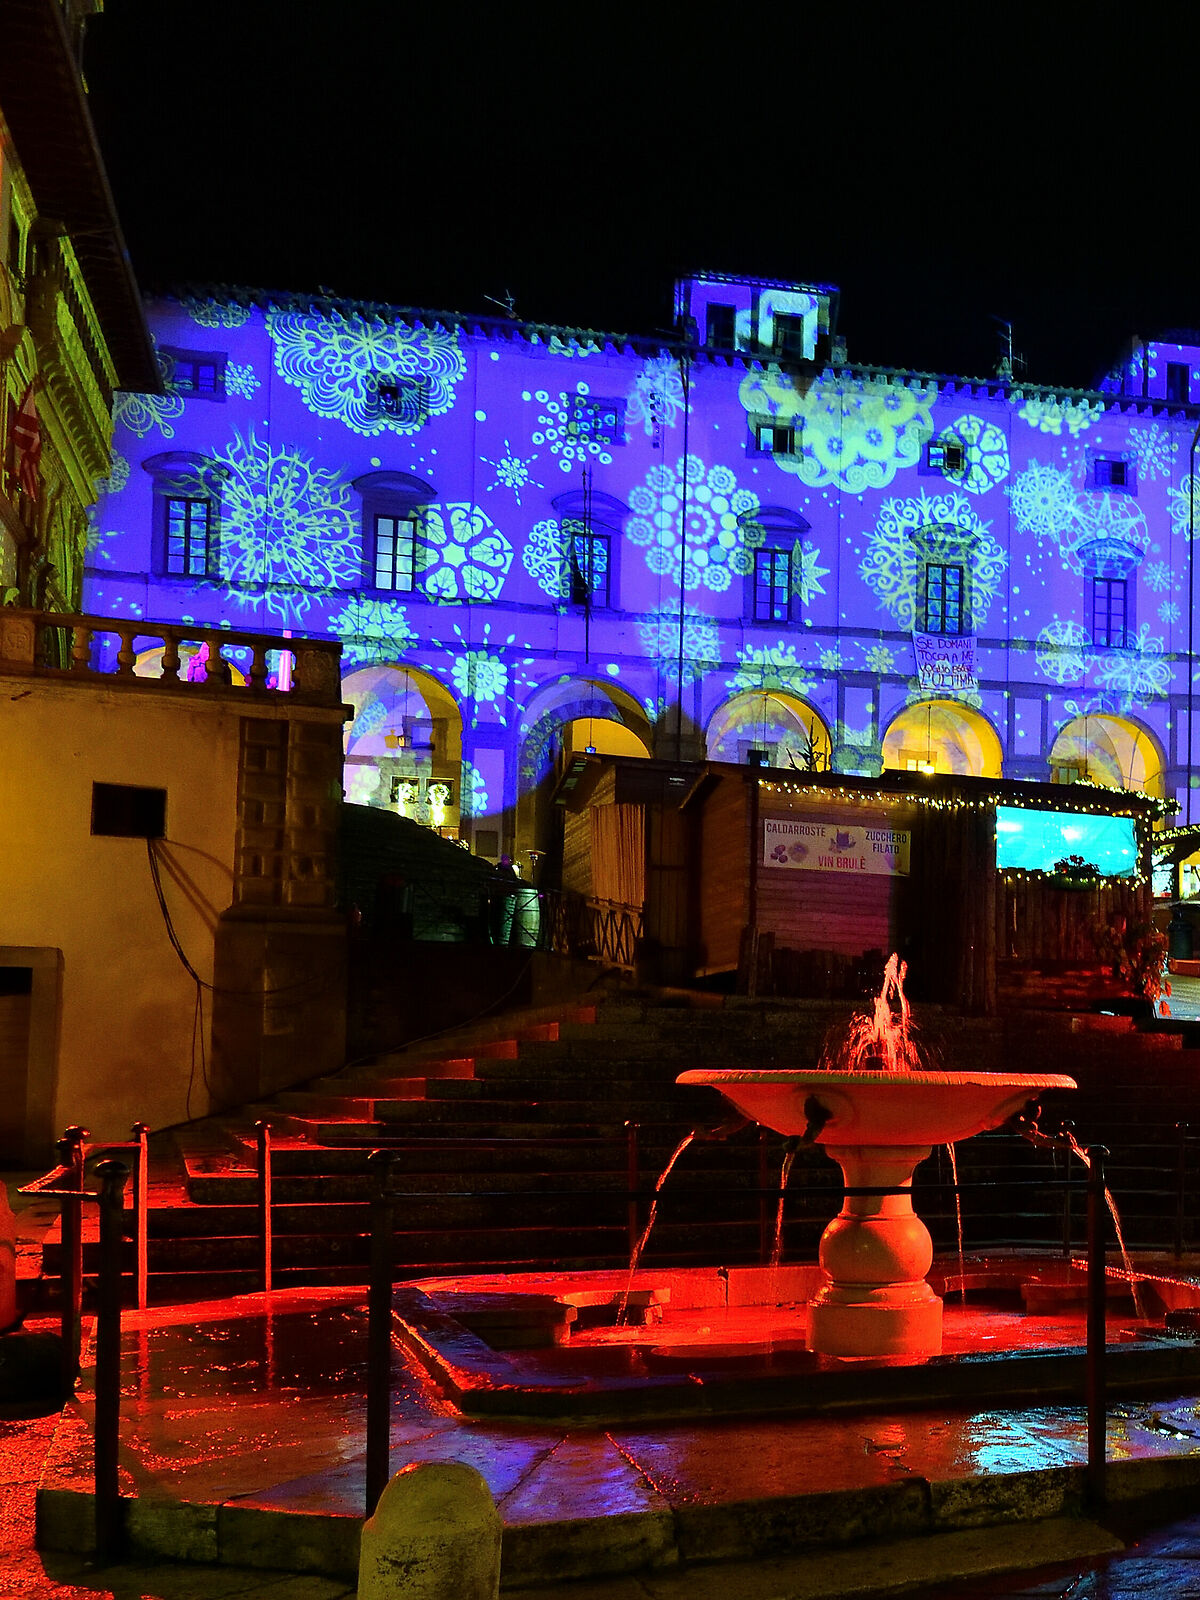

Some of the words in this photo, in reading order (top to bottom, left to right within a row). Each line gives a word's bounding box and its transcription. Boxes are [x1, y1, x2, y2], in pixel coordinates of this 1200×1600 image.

[916, 636, 934, 650] SE
[938, 638, 972, 650] DOMANI
[918, 649, 950, 662] TOCCA
[951, 653, 959, 664] A
[766, 823, 826, 838] CALDARROSTE
[865, 830, 908, 844] ZUCCHERO
[872, 843, 901, 855] FILATO
[818, 855, 834, 868] VIN
[836, 856, 867, 870] BRULÈ
